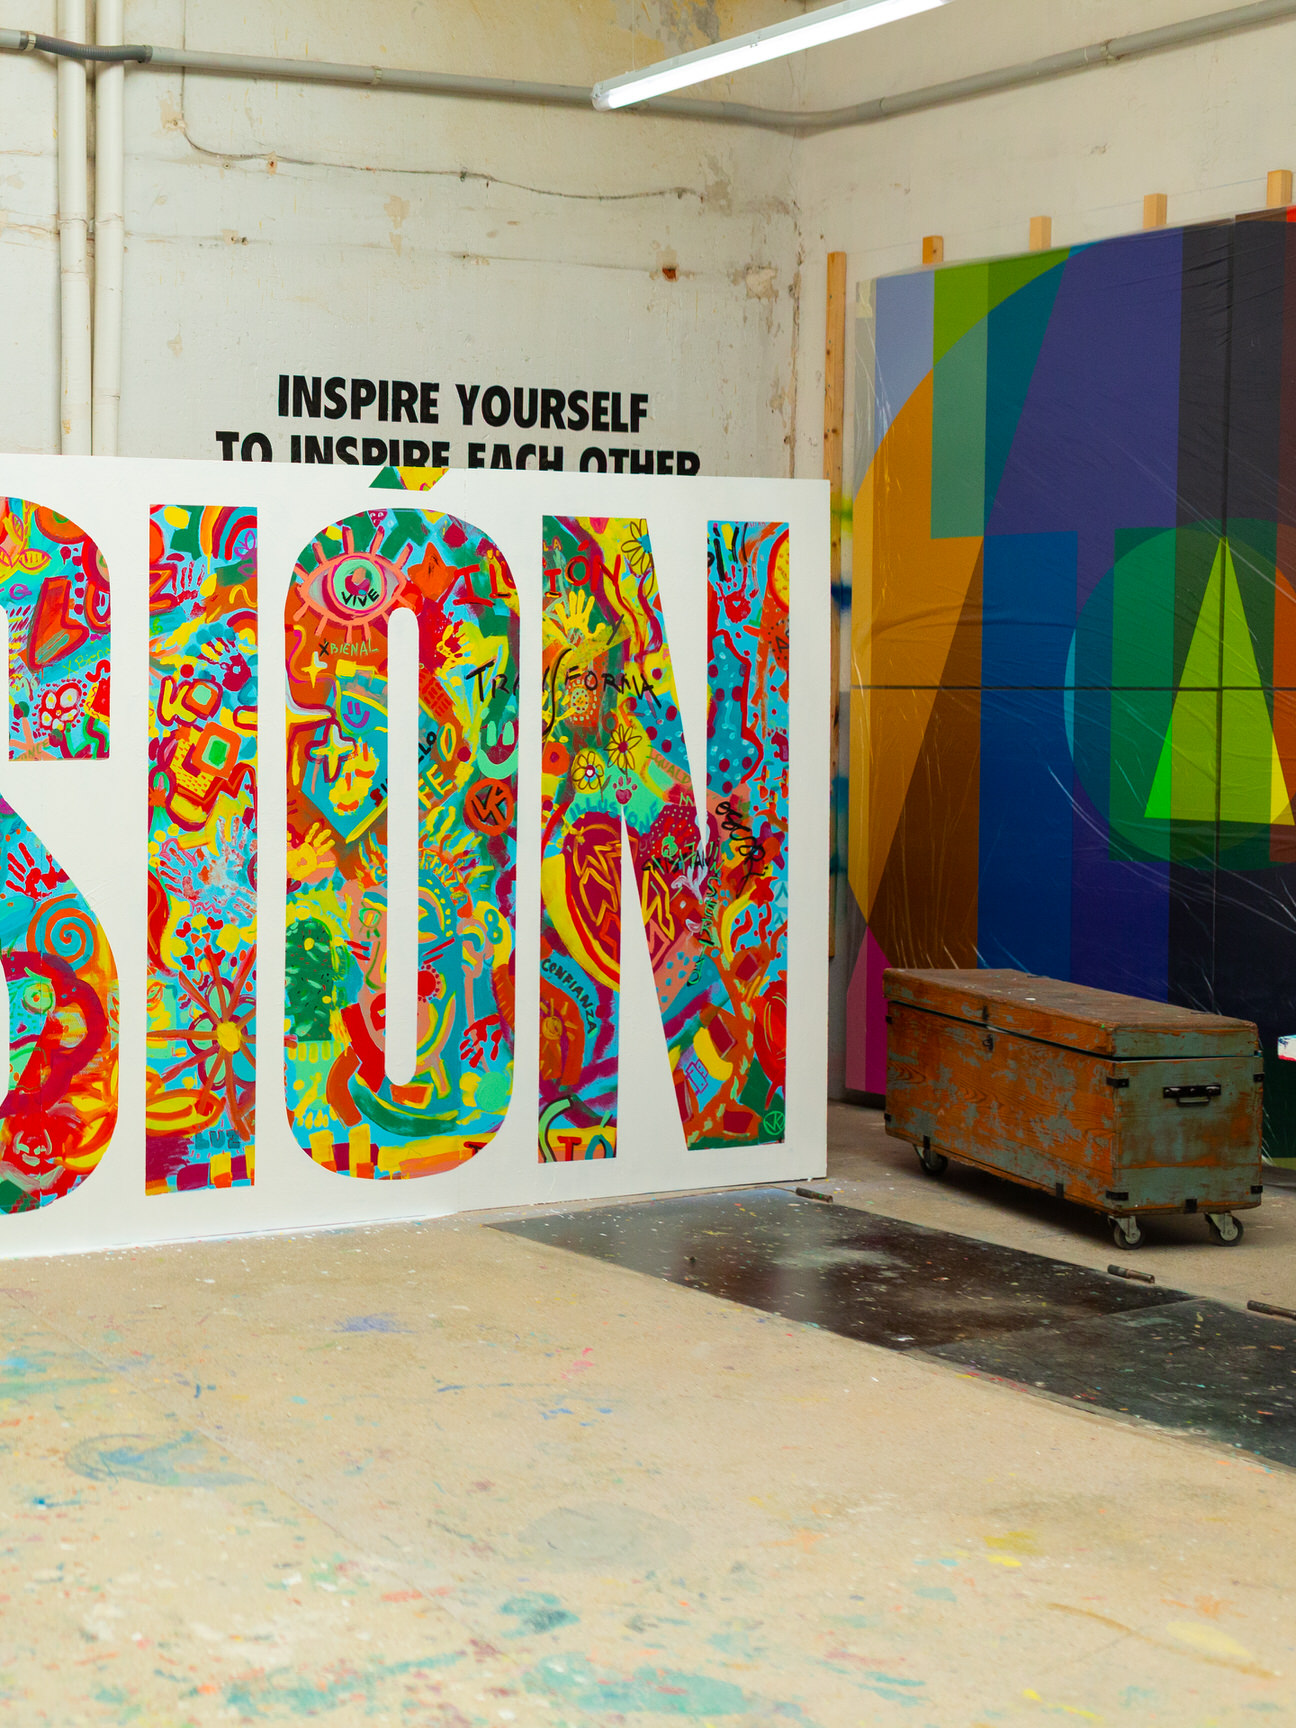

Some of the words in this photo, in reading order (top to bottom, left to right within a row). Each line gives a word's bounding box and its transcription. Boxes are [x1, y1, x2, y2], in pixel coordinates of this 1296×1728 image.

[278, 374, 440, 424] INSPIRE
[455, 384, 649, 433] YOURSELF
[215, 430, 273, 462] TO
[290, 435, 450, 469] INSPIRE
[468, 442, 564, 471] EACH
[580, 447, 702, 477] OTHER
[341, 588, 380, 607] VIVE
[541, 957, 598, 1037] CONFIANZA
[194, 1129, 241, 1150] LUZ
